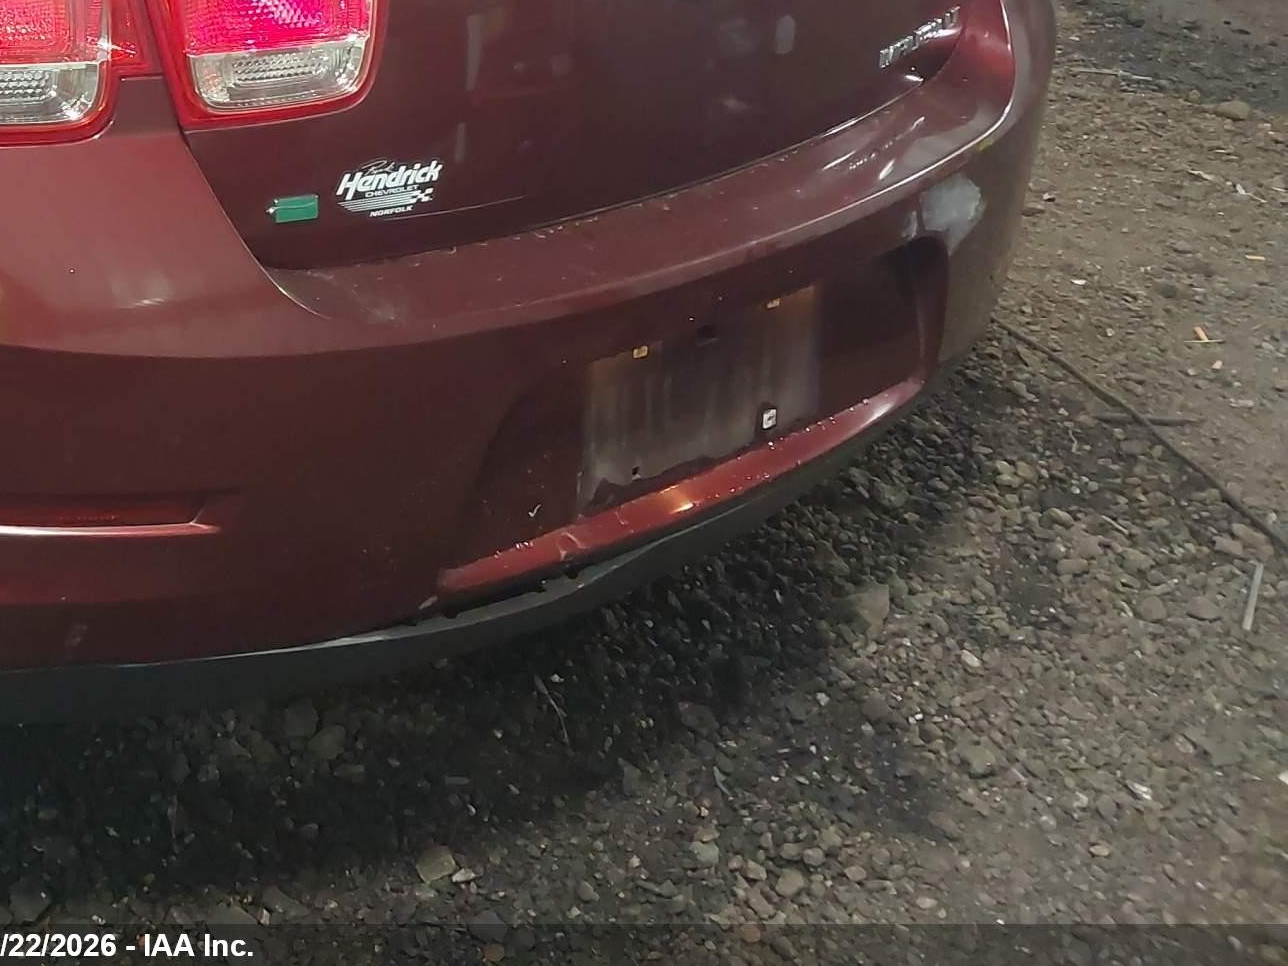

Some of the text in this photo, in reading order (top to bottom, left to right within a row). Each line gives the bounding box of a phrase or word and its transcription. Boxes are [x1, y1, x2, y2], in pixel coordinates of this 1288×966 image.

[335, 160, 443, 201] Hendrick
[365, 184, 420, 198] CHEVROLET
[369, 204, 414, 218] NORFOLK
